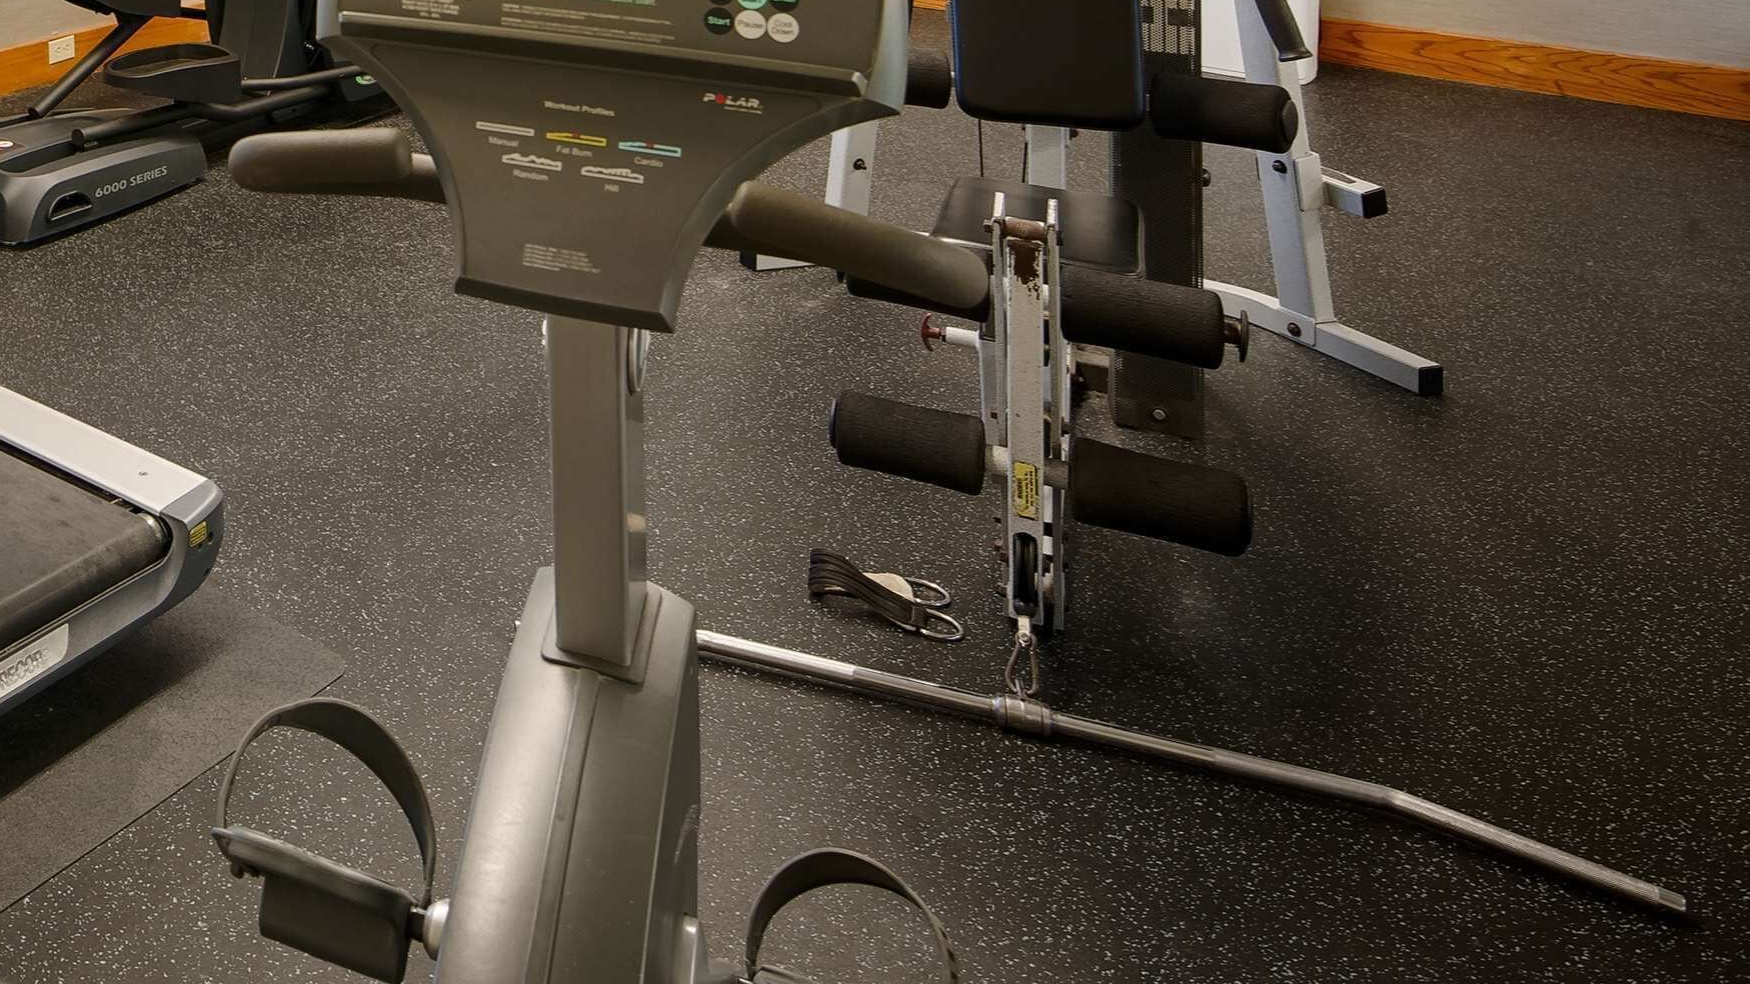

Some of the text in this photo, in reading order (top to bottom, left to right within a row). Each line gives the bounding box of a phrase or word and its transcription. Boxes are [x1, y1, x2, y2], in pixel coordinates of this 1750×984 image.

[707, 15, 731, 26] Start
[702, 92, 760, 108] POLAR
[543, 100, 616, 117] Workout Profiles
[487, 135, 520, 148] Manual
[555, 144, 594, 158] Fat Burn
[633, 156, 664, 168] Cardio
[95, 165, 168, 198] 6000 SERIES
[512, 168, 549, 182] Random
[604, 183, 620, 193] Hill
